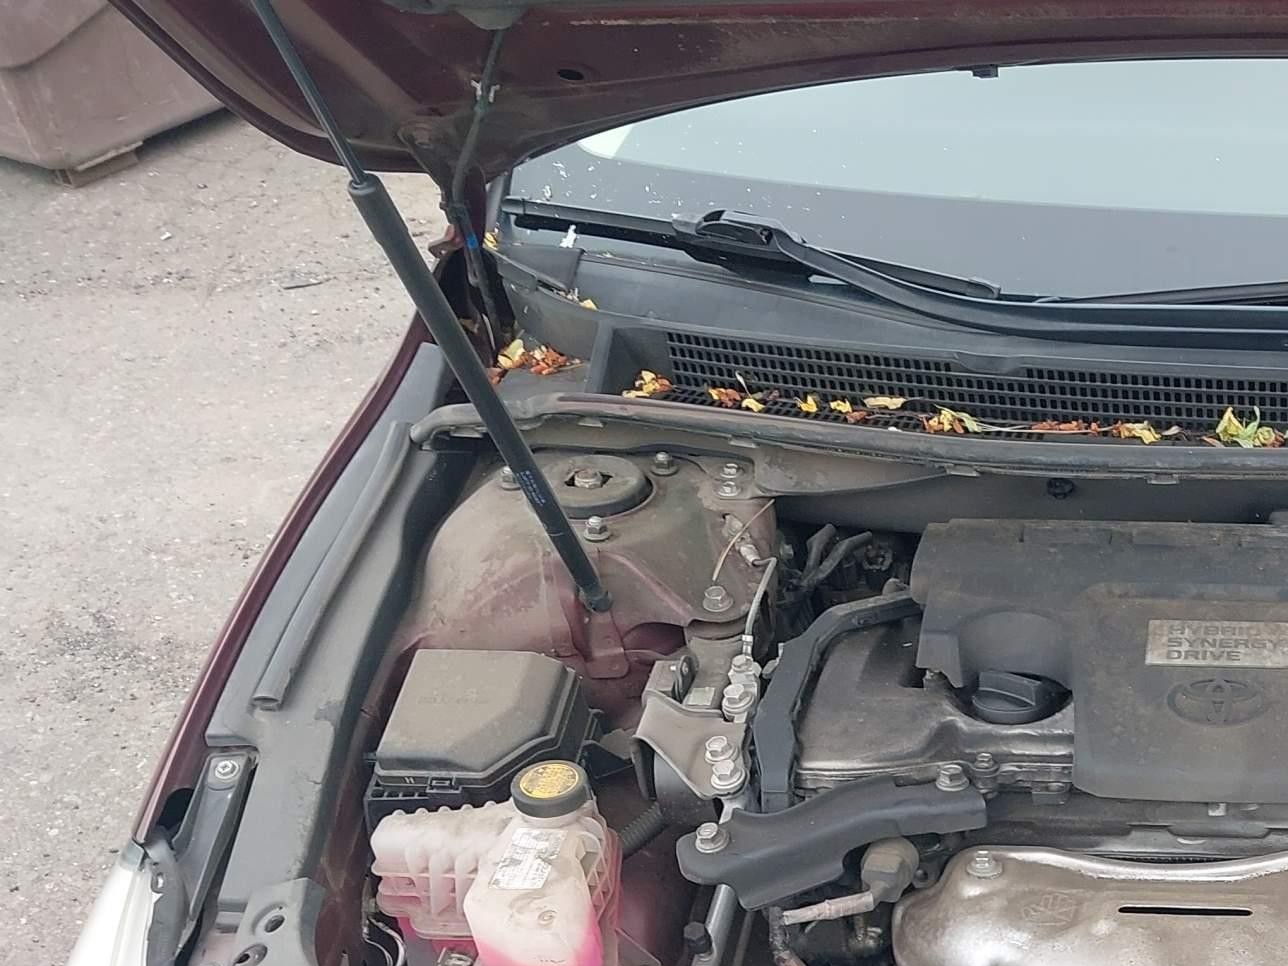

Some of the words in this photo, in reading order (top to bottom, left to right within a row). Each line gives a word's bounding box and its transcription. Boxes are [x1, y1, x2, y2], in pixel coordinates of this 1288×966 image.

[1168, 624, 1261, 636] HYBRID
[1167, 637, 1279, 649] SYNERGY
[1166, 650, 1241, 662] DRIVE
